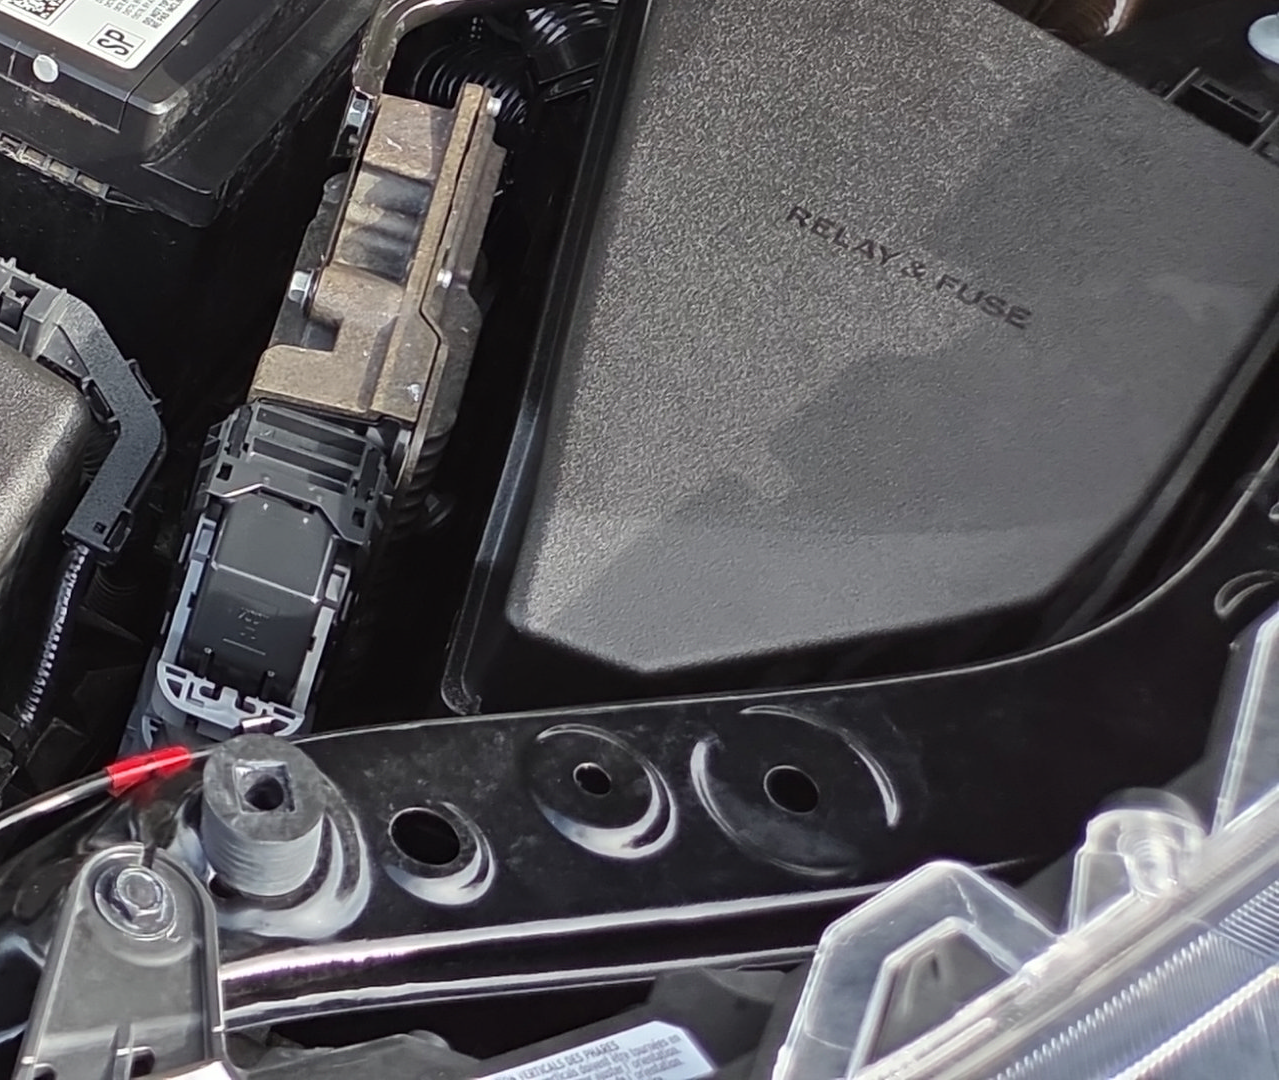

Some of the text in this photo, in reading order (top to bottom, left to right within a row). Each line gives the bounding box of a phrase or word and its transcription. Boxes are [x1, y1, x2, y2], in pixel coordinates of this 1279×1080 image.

[96, 27, 137, 58] SP
[786, 204, 1032, 332] RELAY & FUSE
